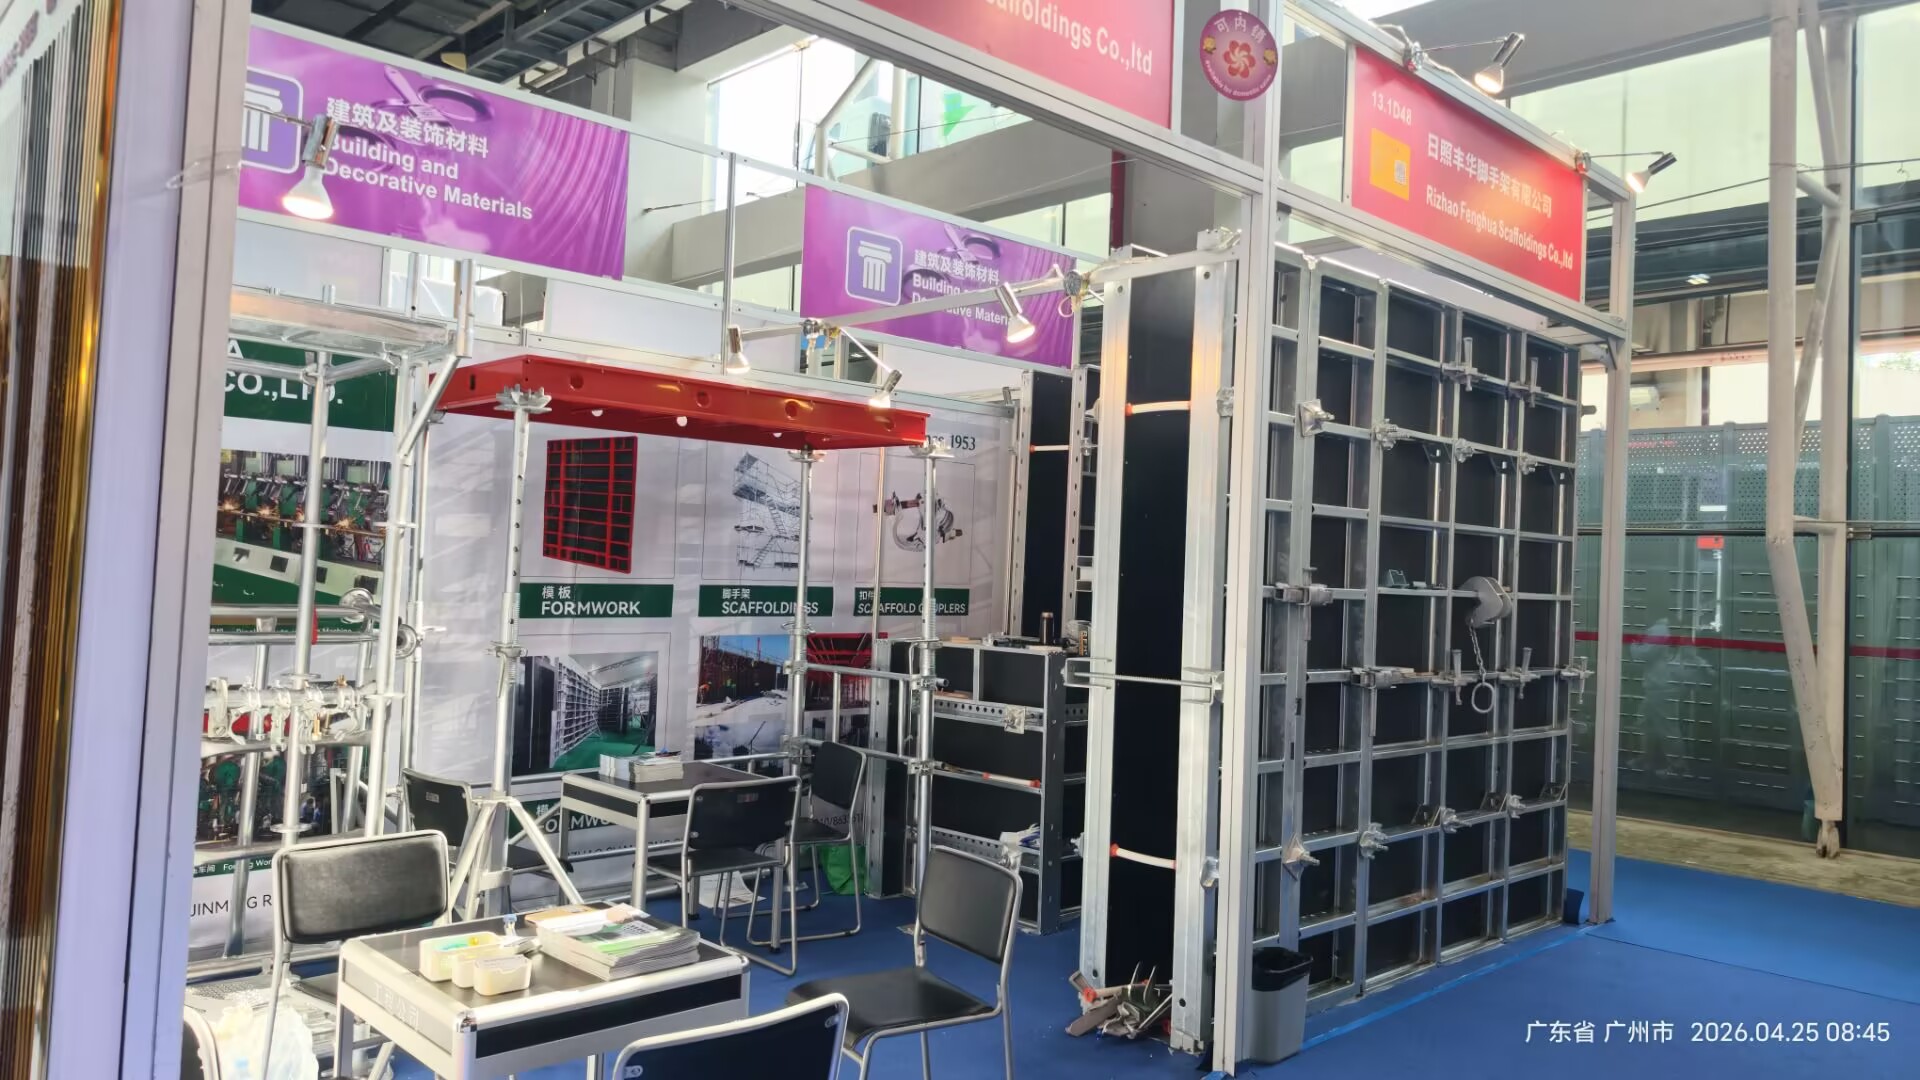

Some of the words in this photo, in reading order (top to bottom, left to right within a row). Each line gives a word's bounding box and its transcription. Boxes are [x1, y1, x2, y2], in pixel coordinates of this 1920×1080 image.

[1096, 27, 1153, 76] Co.,ltd
[1371, 90, 1412, 127] 13.1D48
[326, 96, 489, 159] 建筑及装饰材料
[421, 158, 458, 180] and
[1427, 133, 1552, 218] 日照丰华脚手架有限公司
[324, 157, 438, 199] Decorative
[444, 184, 533, 220] Materials
[1426, 185, 1459, 217] Rizhao
[1460, 202, 1497, 233] Fenghua
[1498, 220, 1548, 260] Scaffoldings
[914, 249, 999, 285] 建筑及装饰材料
[975, 306, 1009, 325] Materi
[951, 434, 976, 451] 1953
[541, 600, 641, 616] FORMWORK
[722, 588, 751, 600] 脚手架
[190, 896, 258, 917] JINMG
